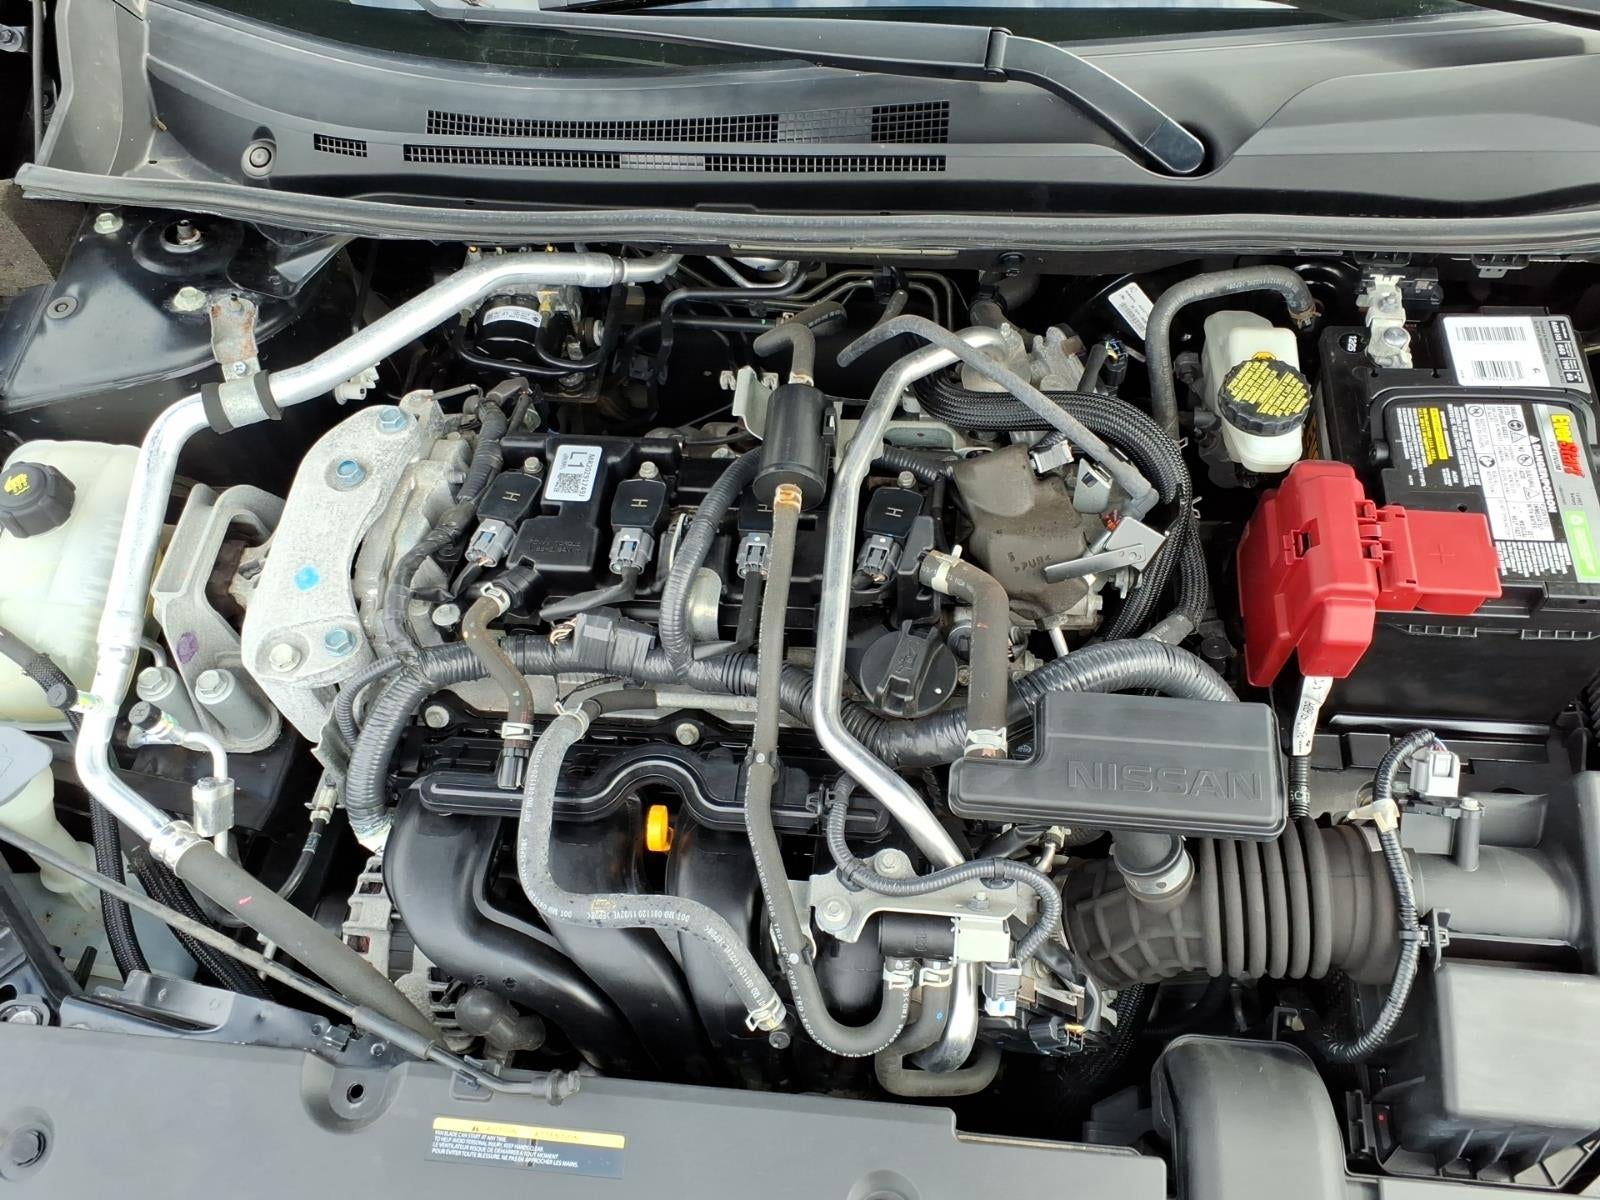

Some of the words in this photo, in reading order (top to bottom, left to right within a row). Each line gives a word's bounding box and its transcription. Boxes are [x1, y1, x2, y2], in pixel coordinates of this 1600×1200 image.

[567, 452, 587, 467] L1
[1550, 441, 1562, 471] PLATINUM
[1532, 444, 1558, 512] DANGER/POISON
[1068, 760, 1263, 801] NISSAN
[432, 1147, 445, 1155] POUR
[462, 1150, 476, 1158] TOUTE
[525, 1157, 553, 1165] APPROCHER
[439, 1142, 469, 1150] VENTILATEUR
